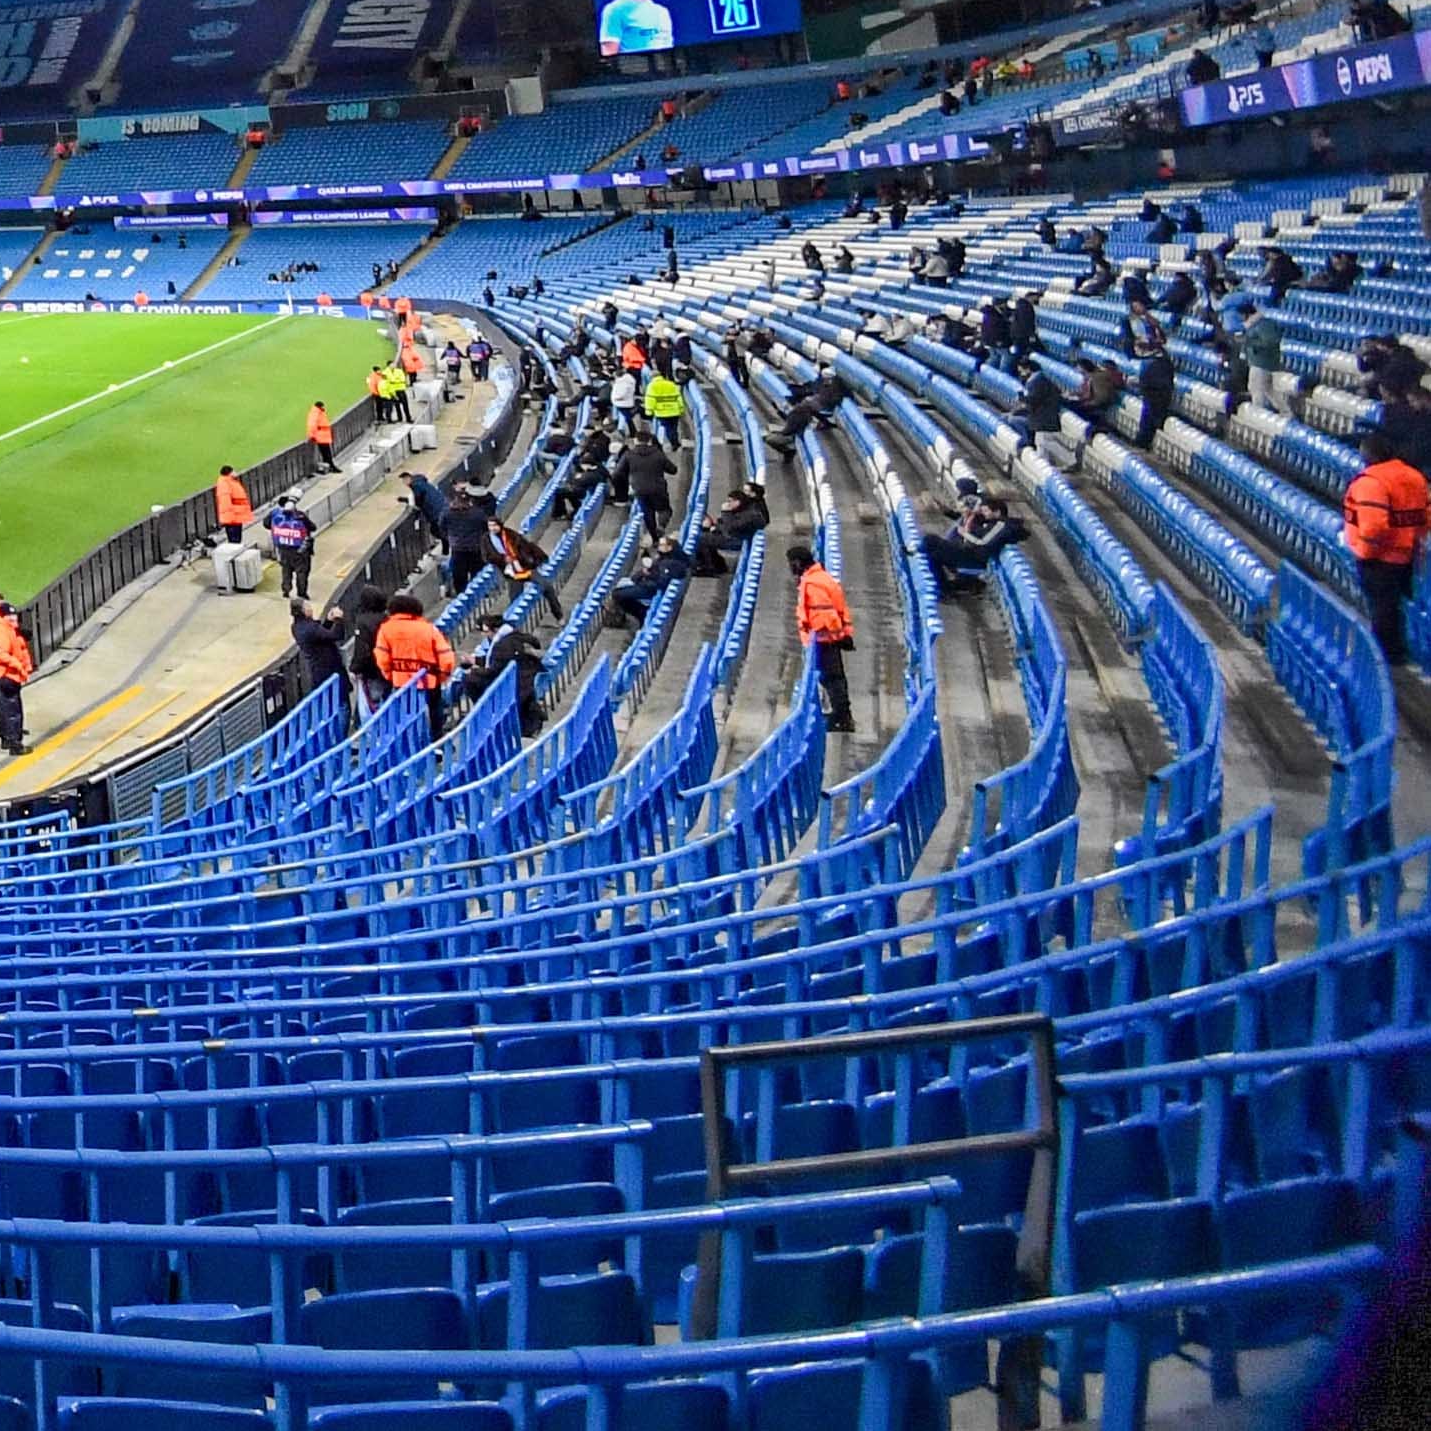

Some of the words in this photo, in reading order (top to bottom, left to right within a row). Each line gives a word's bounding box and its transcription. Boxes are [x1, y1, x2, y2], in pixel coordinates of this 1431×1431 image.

[1355, 53, 1393, 86] PEPSI
[121, 119, 135, 135] IS
[142, 114, 200, 134] COMING
